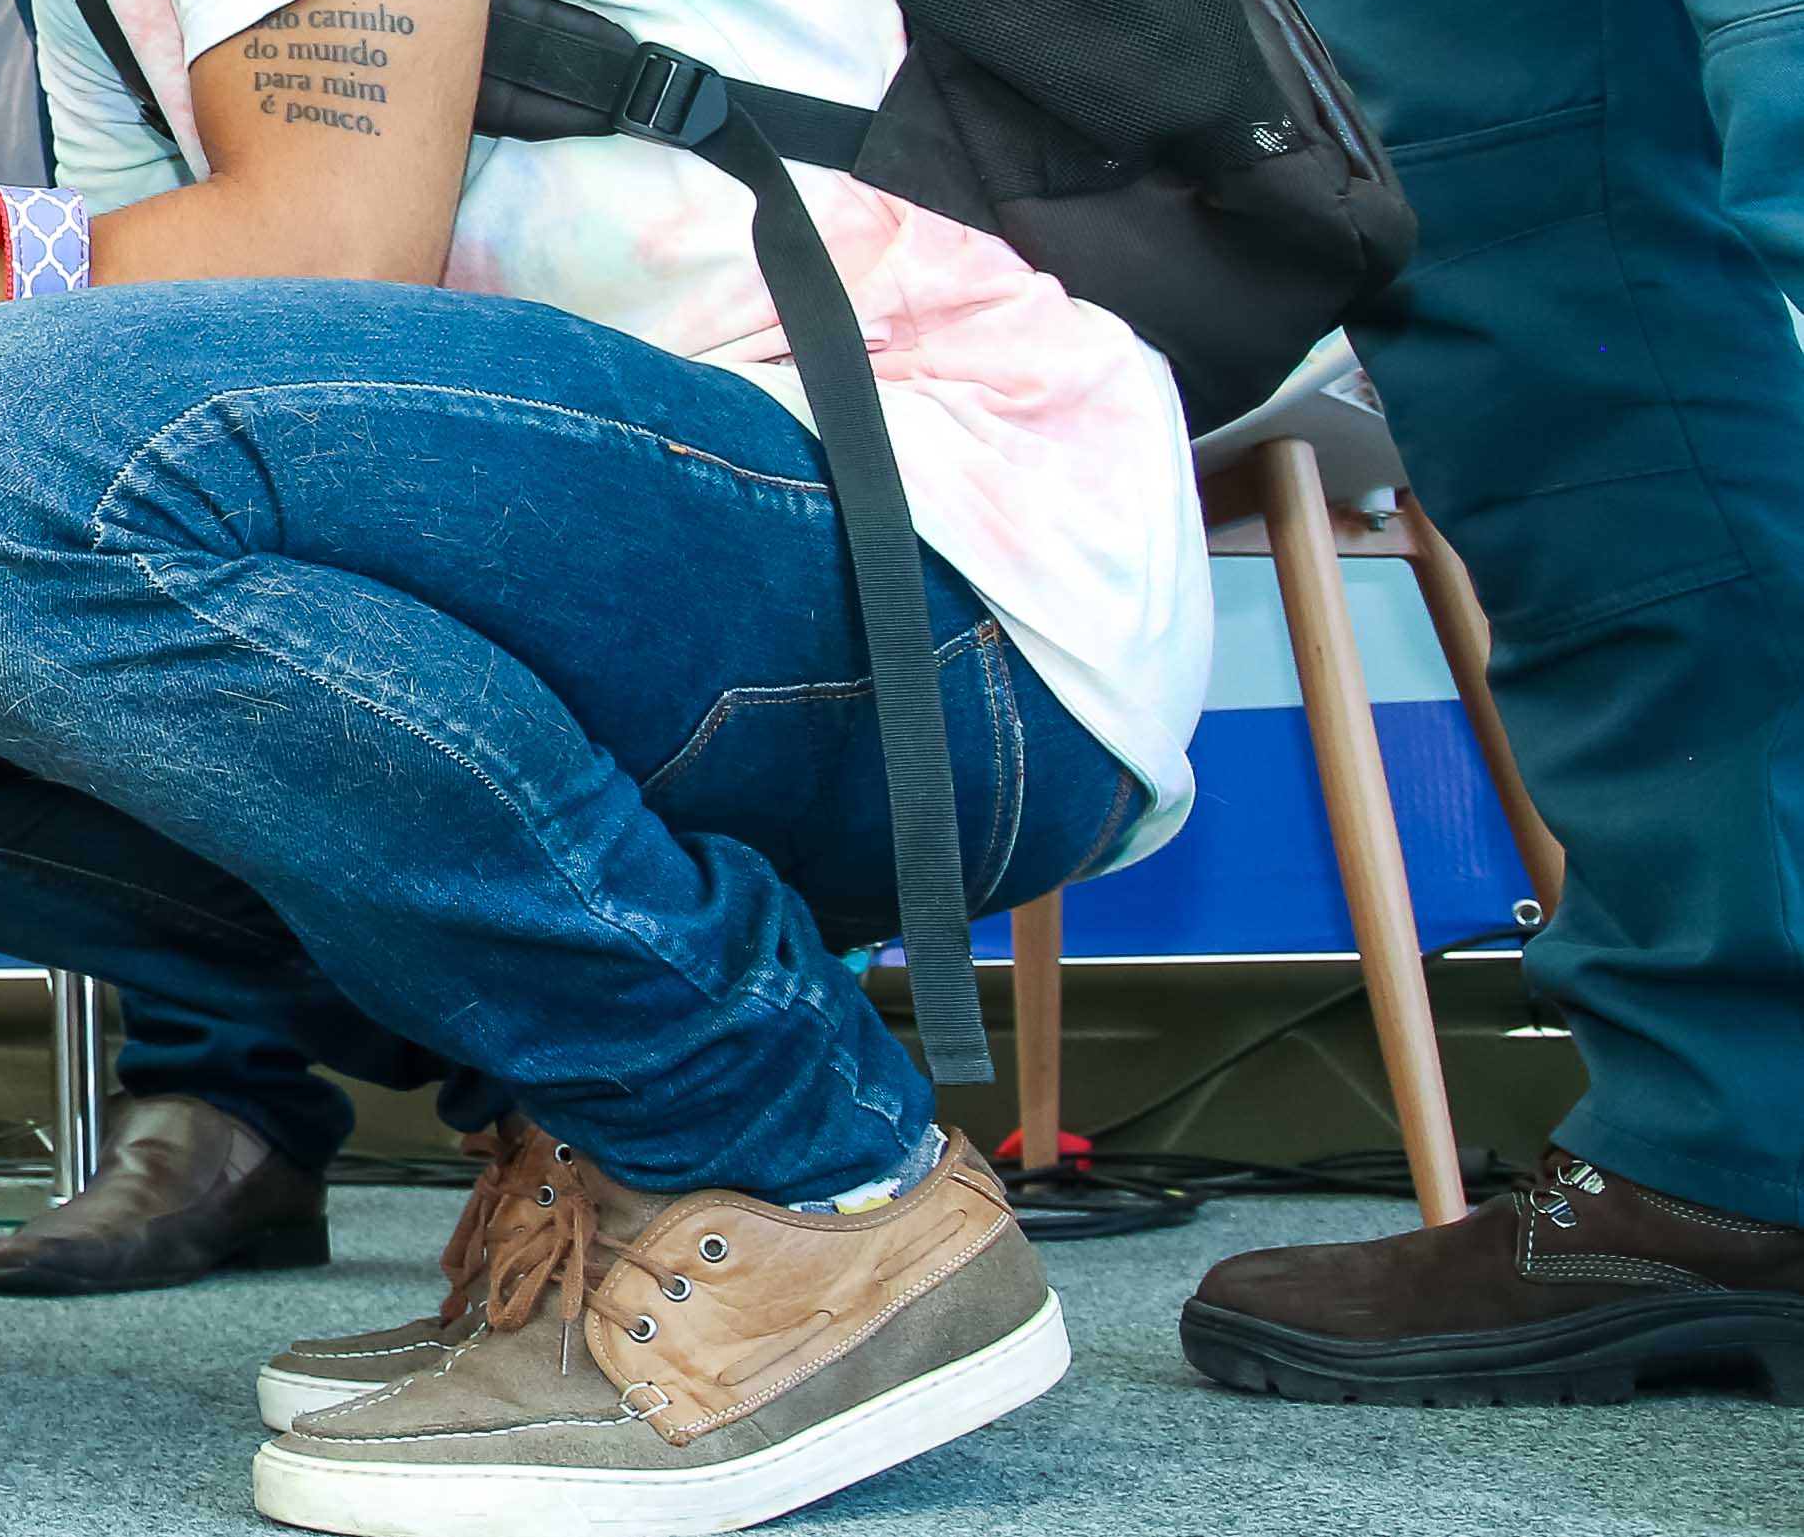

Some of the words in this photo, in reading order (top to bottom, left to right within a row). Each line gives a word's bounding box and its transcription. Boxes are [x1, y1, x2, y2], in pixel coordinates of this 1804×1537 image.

[308, 1, 415, 36] carinho
[243, 37, 279, 60] do
[287, 38, 388, 68] mundo
[254, 71, 312, 92] para
[322, 71, 387, 104] mim
[260, 93, 277, 114] é
[285, 100, 381, 137] pouco.
